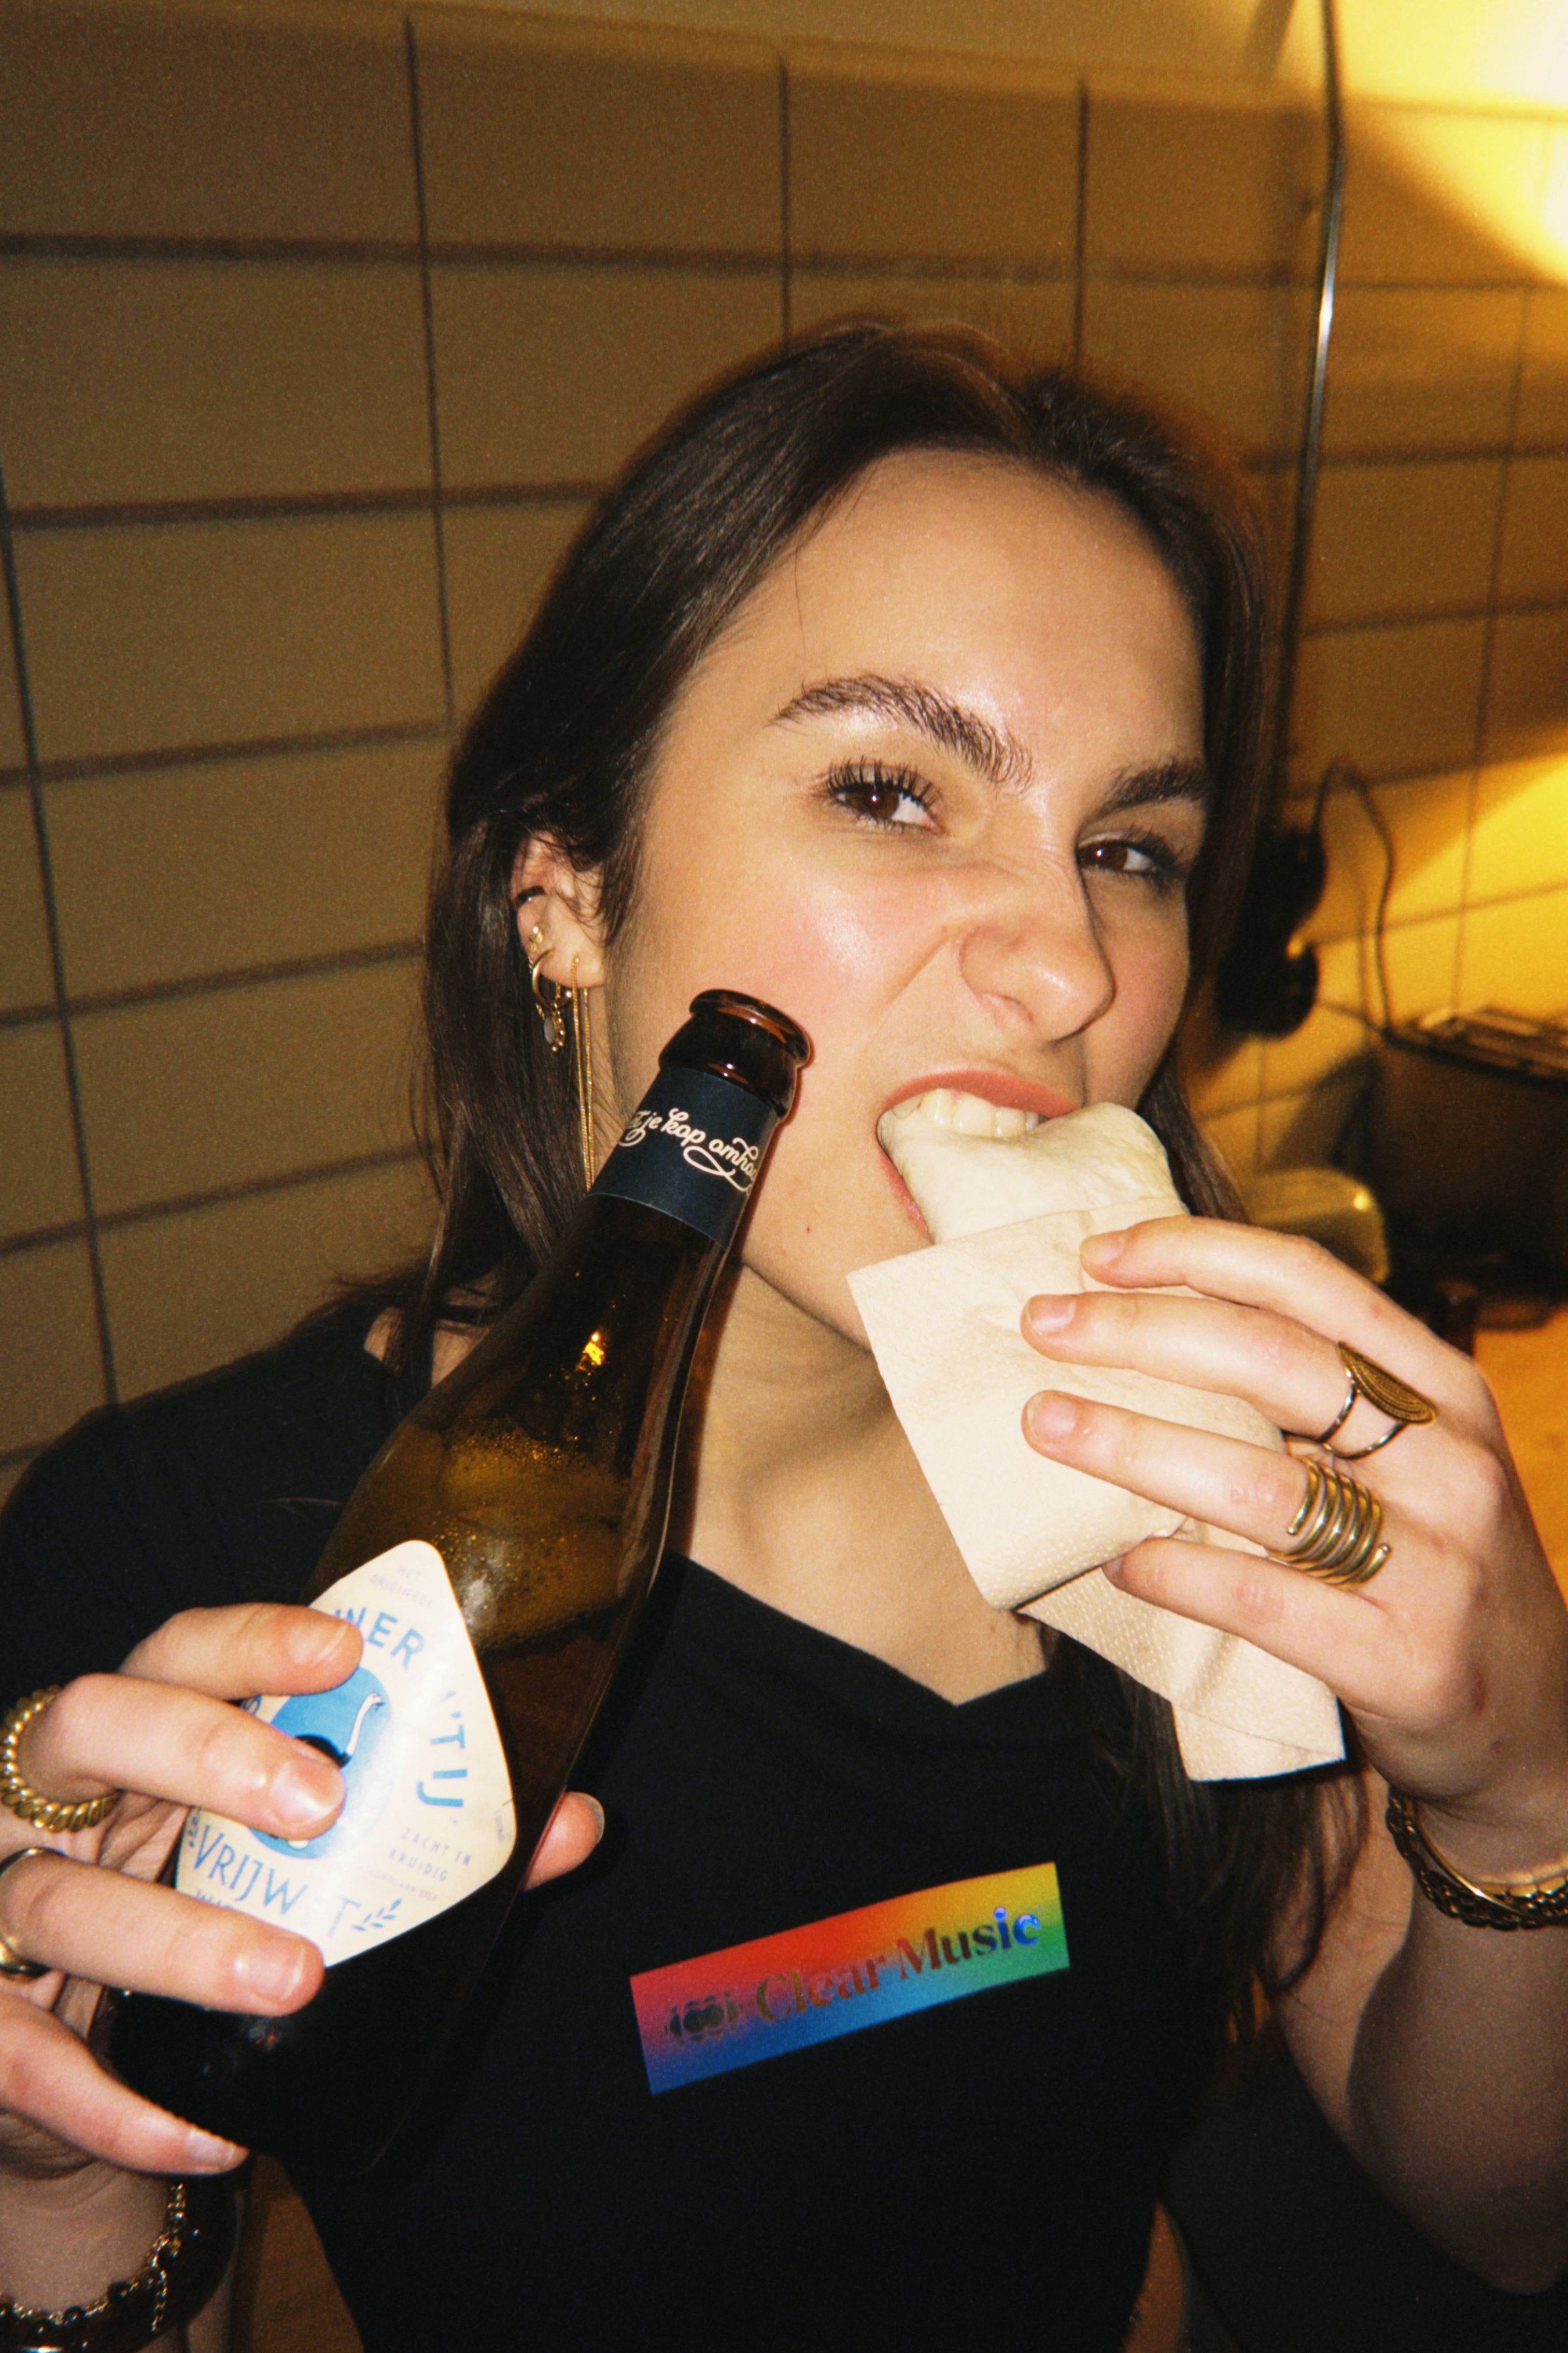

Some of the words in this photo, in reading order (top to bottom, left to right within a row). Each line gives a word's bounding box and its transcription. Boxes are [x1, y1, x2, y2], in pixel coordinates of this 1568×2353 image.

[619, 1112, 663, 1147] je
[401, 1827, 450, 1857] ZACHT
[193, 1824, 362, 1937] VRIJWT
[389, 1847, 448, 1882] KRUIDIG
[756, 1953, 888, 2023] Clear
[896, 1906, 1041, 1980] Music
